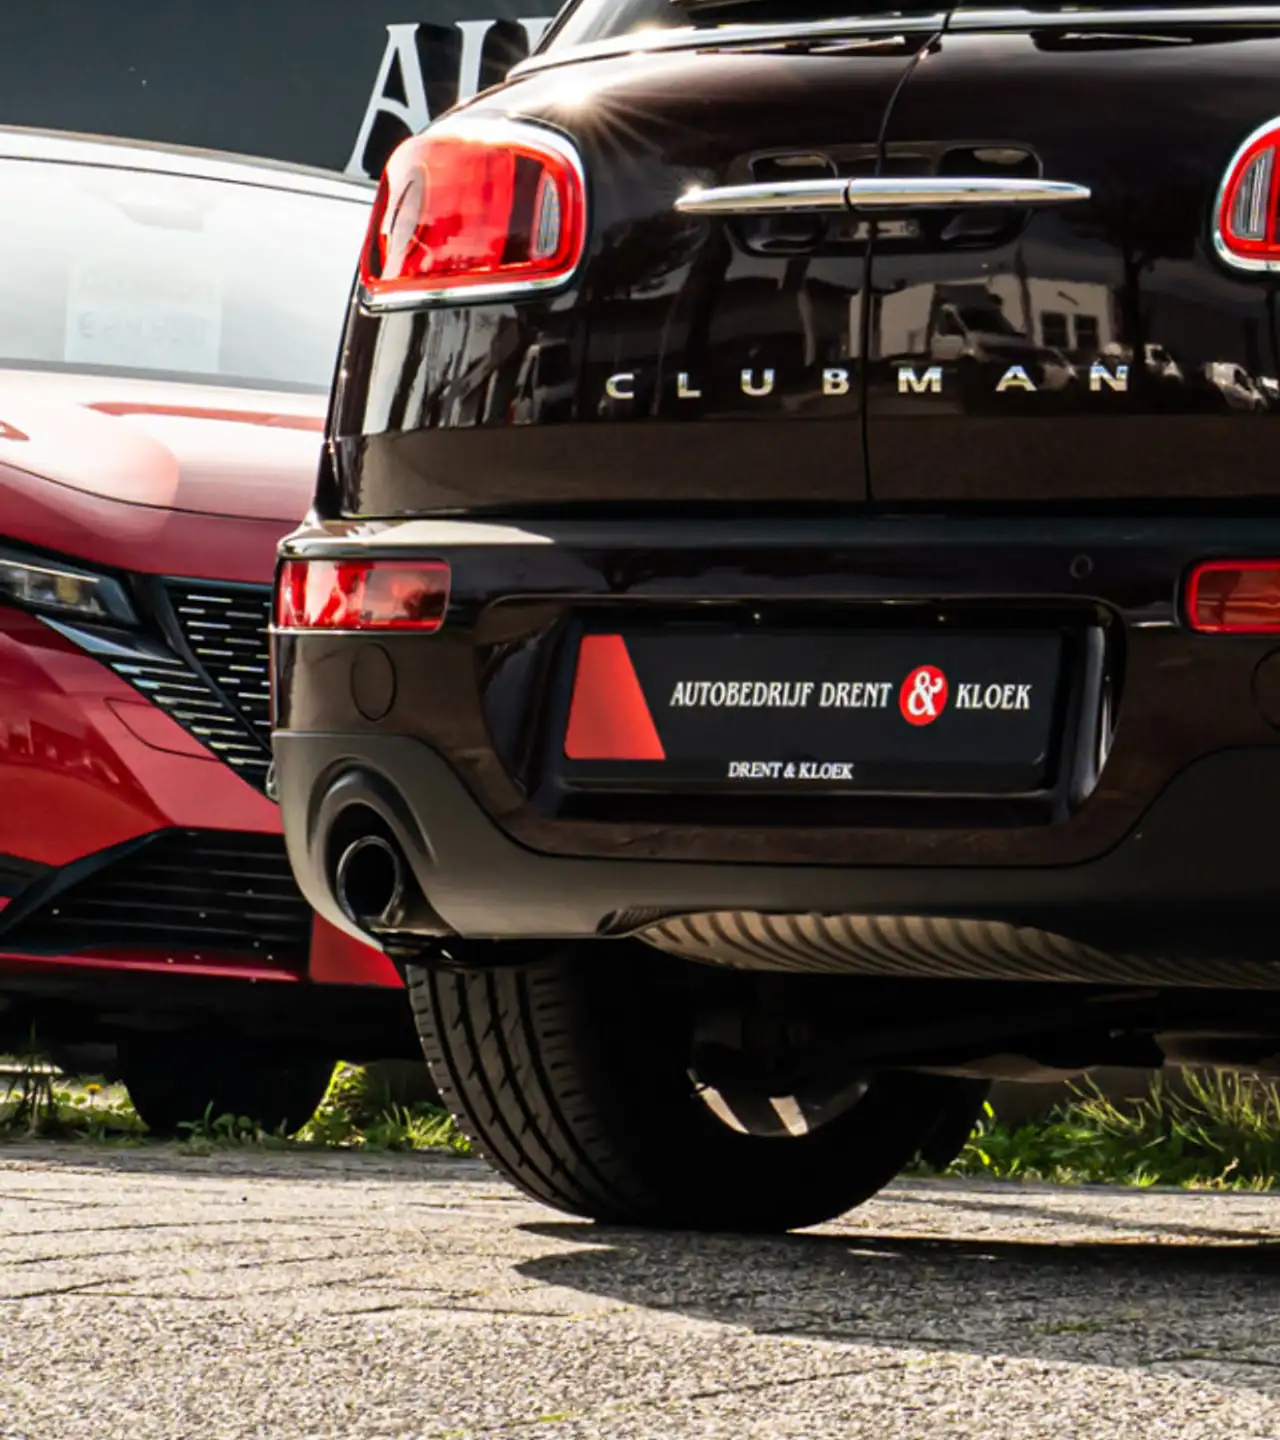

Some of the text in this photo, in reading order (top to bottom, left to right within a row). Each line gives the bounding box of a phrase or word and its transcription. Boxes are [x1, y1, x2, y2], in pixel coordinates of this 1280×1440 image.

[606, 365, 1129, 399] CLUBMAN
[670, 671, 1031, 717] AUTOBEDRIJF DRENT & KLOEK
[727, 762, 853, 780] DRENT & KLOEK
